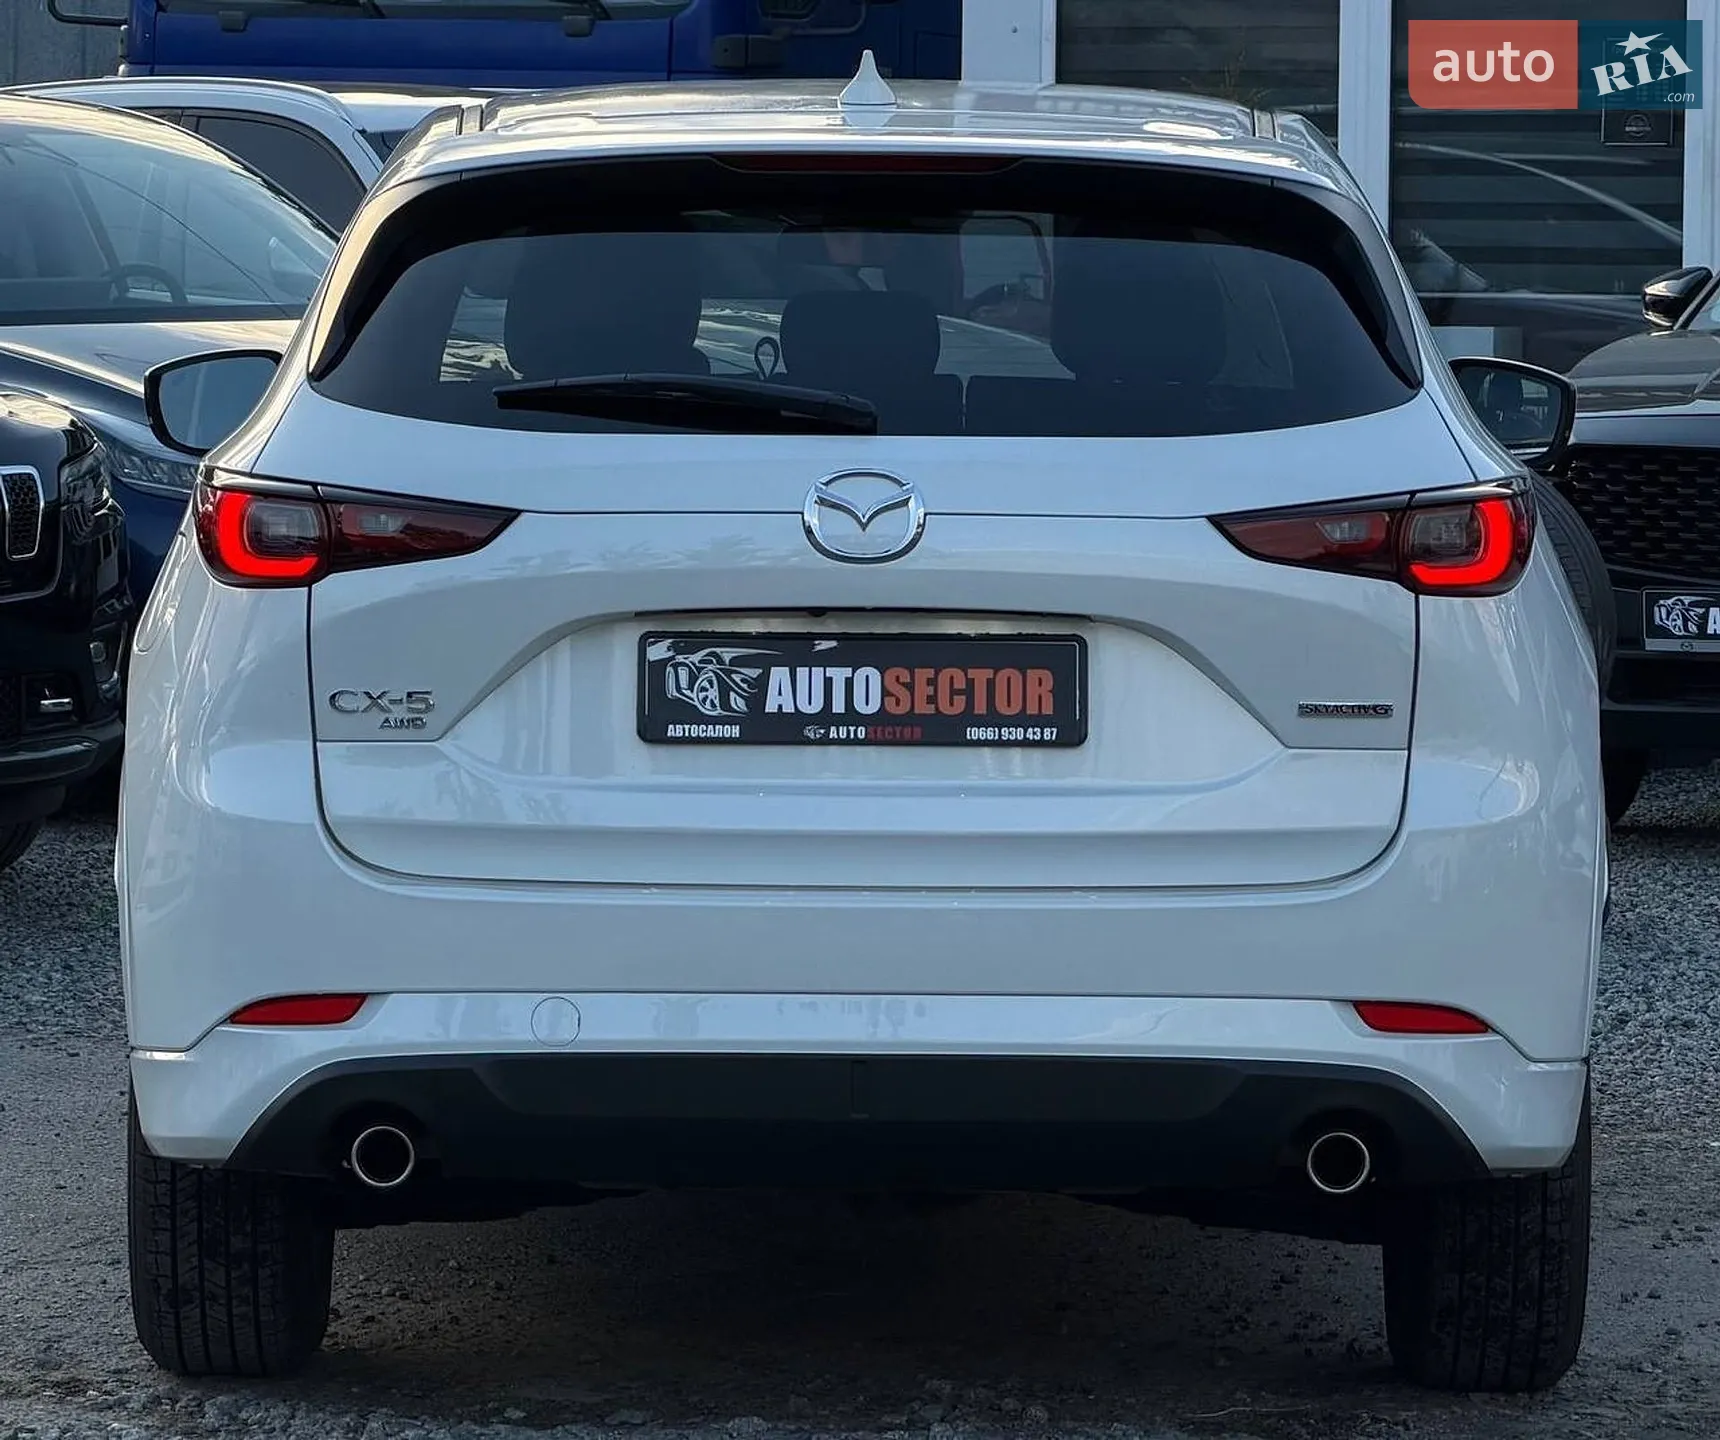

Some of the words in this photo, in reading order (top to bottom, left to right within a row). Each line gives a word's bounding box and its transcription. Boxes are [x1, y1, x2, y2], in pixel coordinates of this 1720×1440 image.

[764, 666, 1054, 715] AUTOSECTOR
[328, 689, 435, 714] CX-5
[379, 717, 427, 730] AWD
[667, 724, 740, 738] АВТОСАЛОН
[966, 727, 999, 740] (066)
[1001, 727, 1024, 740] 930
[1026, 727, 1041, 740] 43
[1043, 727, 1057, 740] 87
